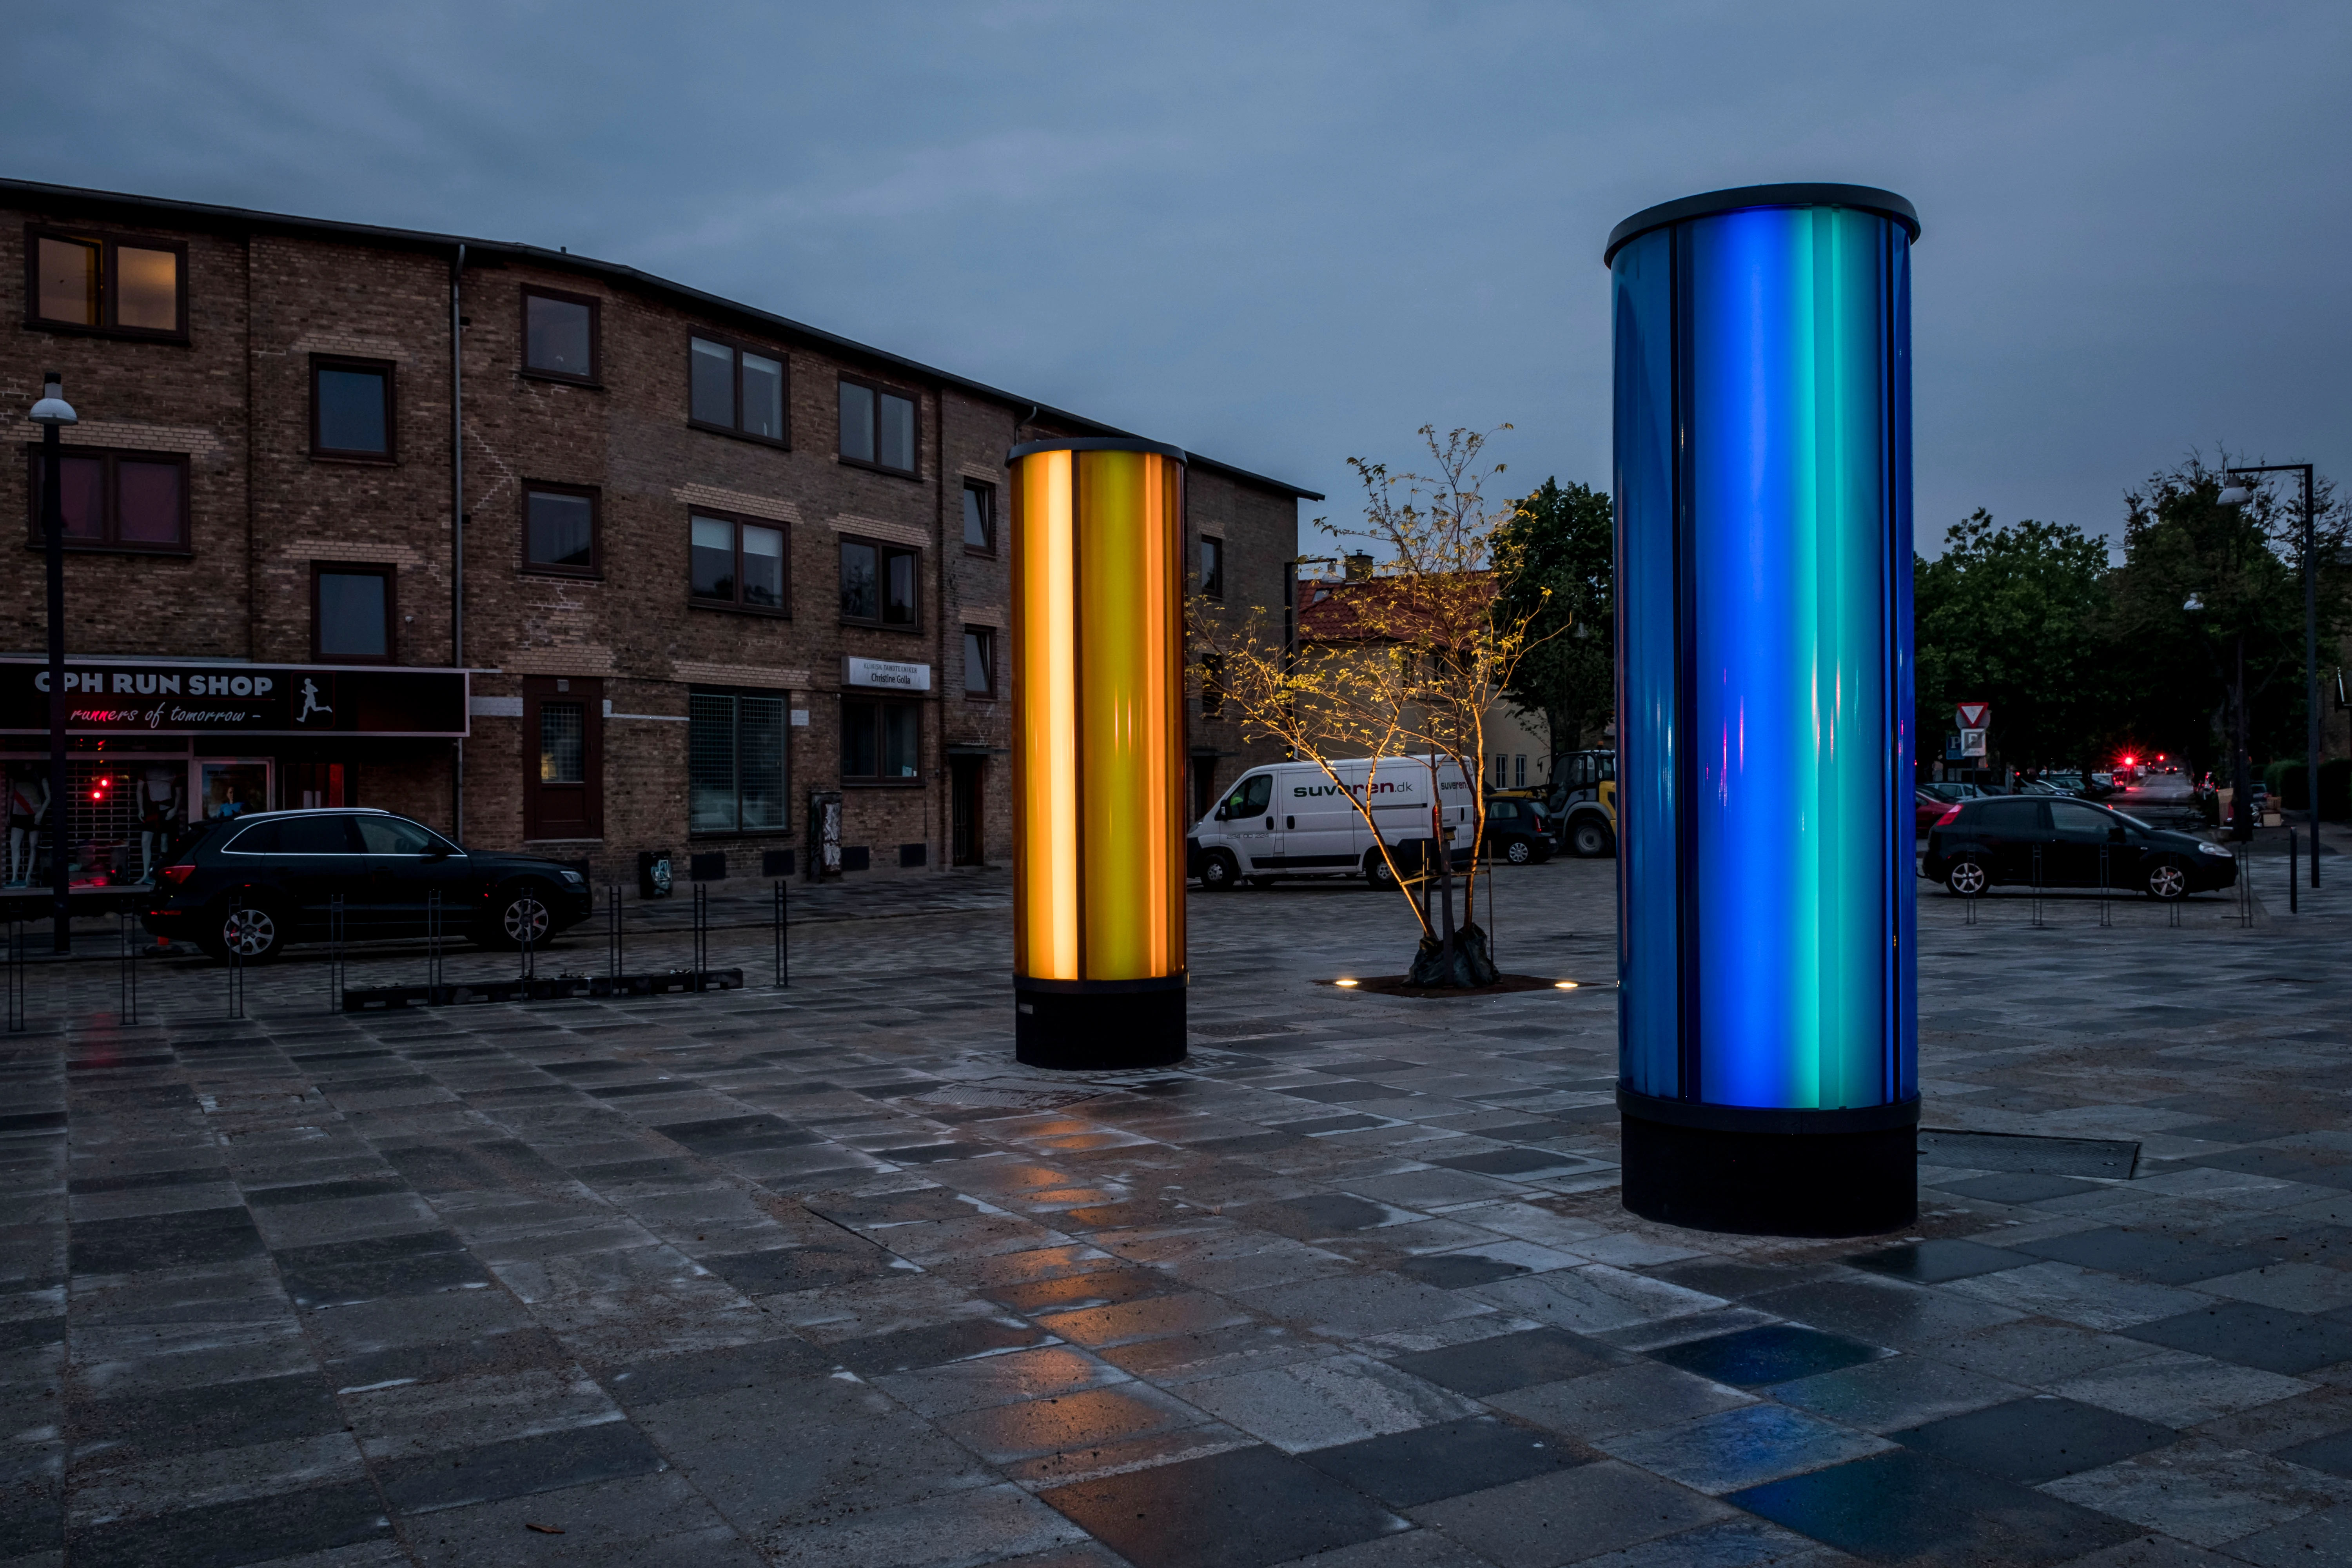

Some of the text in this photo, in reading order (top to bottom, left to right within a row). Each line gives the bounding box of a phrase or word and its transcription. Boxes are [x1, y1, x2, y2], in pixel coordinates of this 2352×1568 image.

[864, 662, 917, 673] KLINISK TANDTEKNIKER
[34, 671, 273, 696] CPH RUN SHOP
[871, 673, 910, 684] Christine Golla
[70, 709, 139, 722] runners
[144, 701, 166, 729] of
[170, 706, 245, 722] tomorrow
[1950, 736, 1961, 749] P
